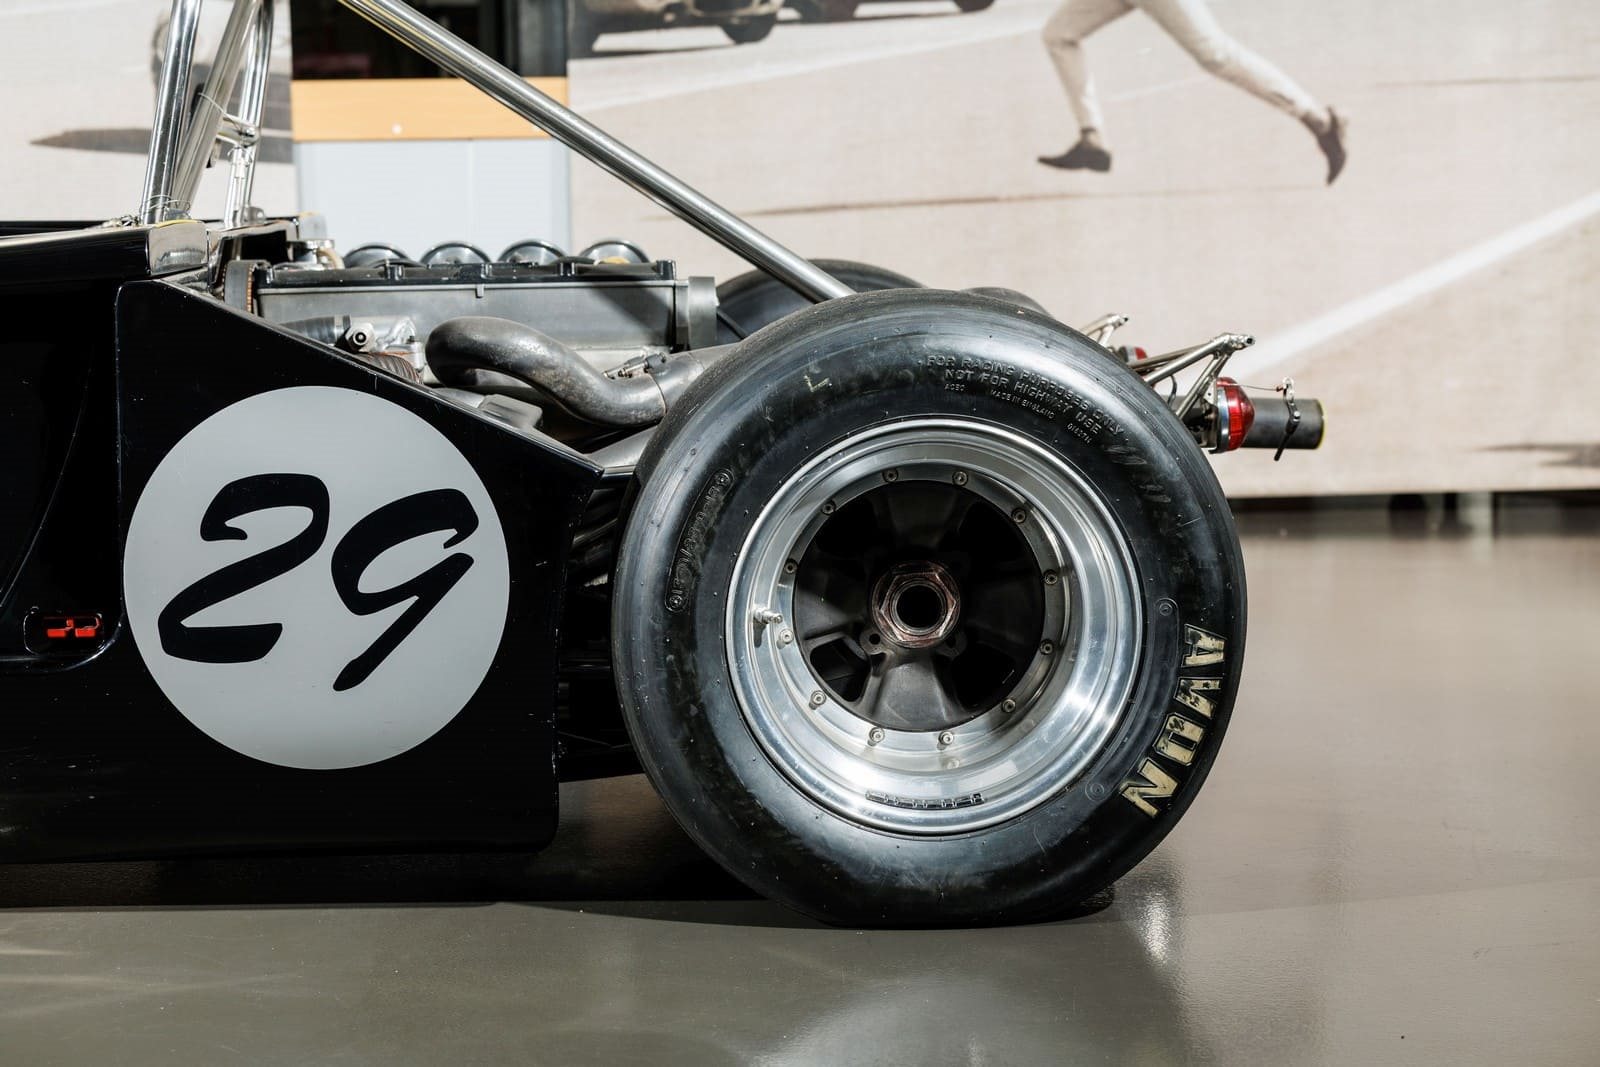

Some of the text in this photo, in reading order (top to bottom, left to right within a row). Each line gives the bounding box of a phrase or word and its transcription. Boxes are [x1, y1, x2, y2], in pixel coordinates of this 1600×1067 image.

[926, 355, 1125, 436] FOR RACING PURPOSES ONLY
[944, 368, 975, 381] NOT
[979, 371, 1010, 388] FOR
[1075, 411, 1102, 435] USE
[158, 473, 479, 692] 29
[1119, 623, 1228, 817] AVON
